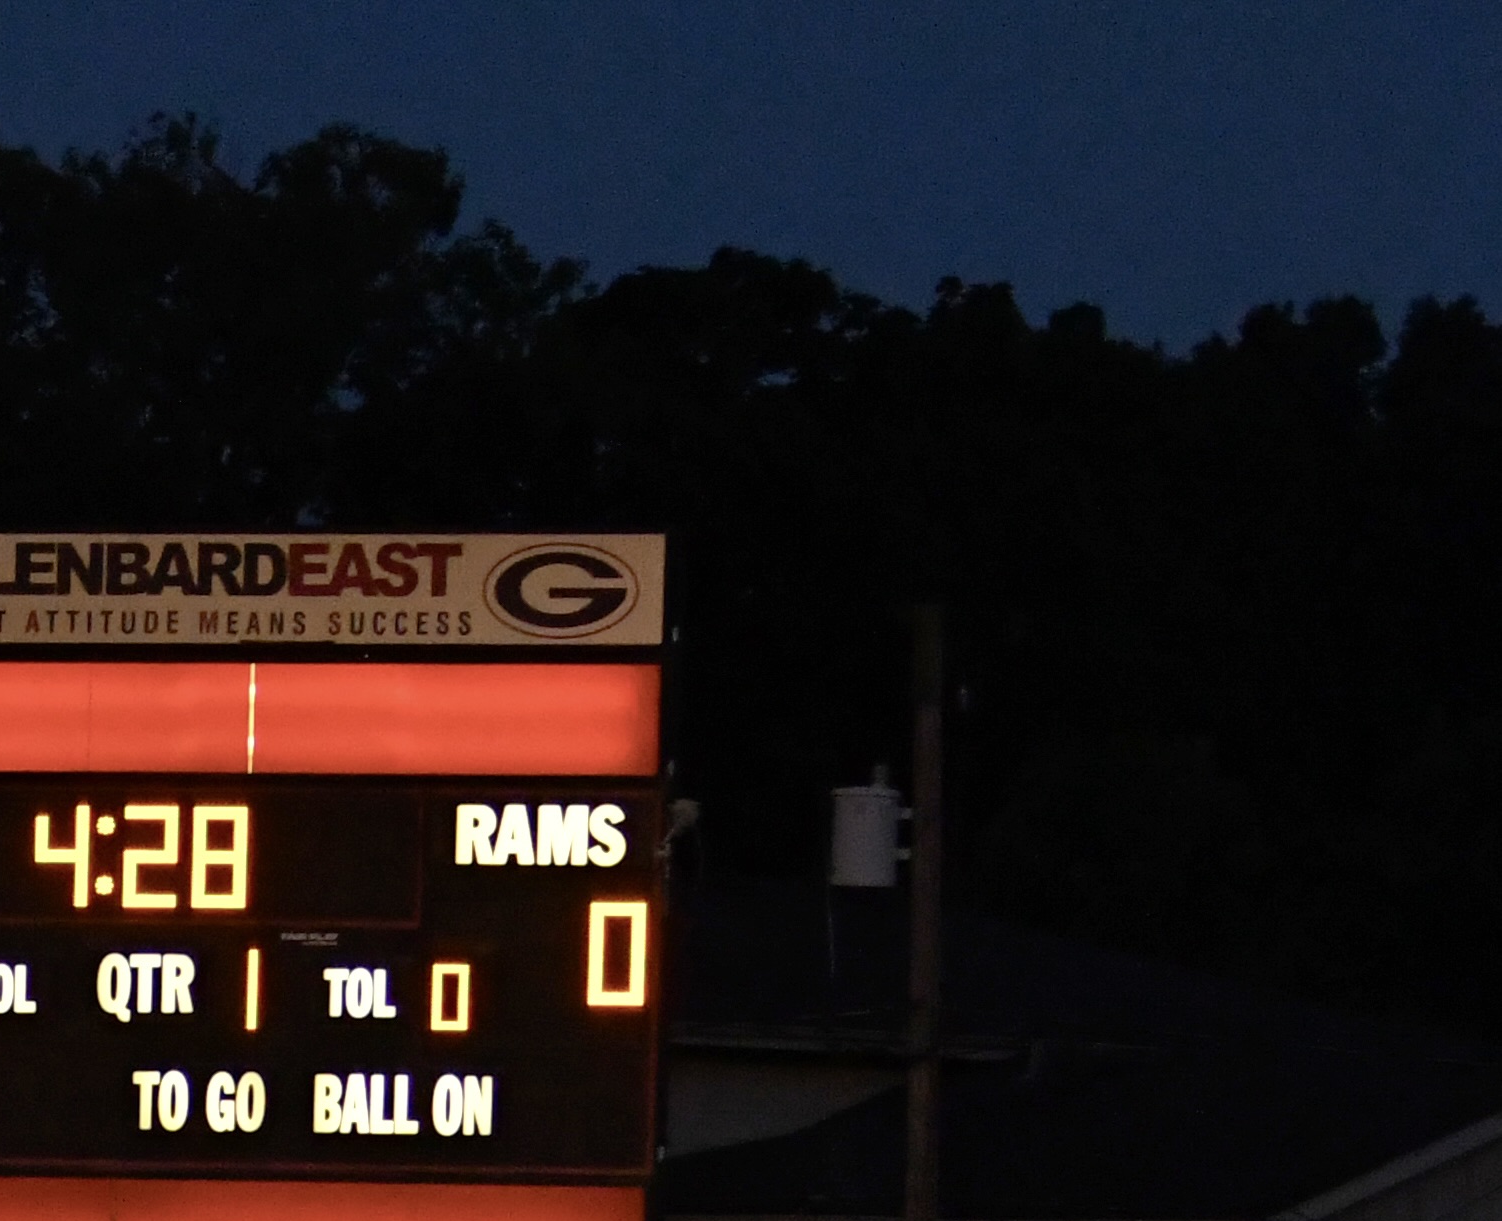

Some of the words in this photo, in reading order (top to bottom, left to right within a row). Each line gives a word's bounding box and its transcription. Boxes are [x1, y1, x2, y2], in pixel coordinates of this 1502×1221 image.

[24, 609, 179, 636] ATTITUDE
[198, 611, 306, 636] MEANS
[328, 611, 473, 636] SUCCESS
[33, 804, 249, 909] 4:28
[455, 803, 627, 867] RAMS
[587, 901, 648, 1007] 0
[97, 952, 196, 1023] QTR
[323, 967, 397, 1019] TOL
[430, 963, 471, 1032] 0
[132, 1070, 189, 1132] TO
[205, 1071, 266, 1132] GO
[313, 1073, 419, 1135] BALL
[432, 1073, 493, 1136] ON
